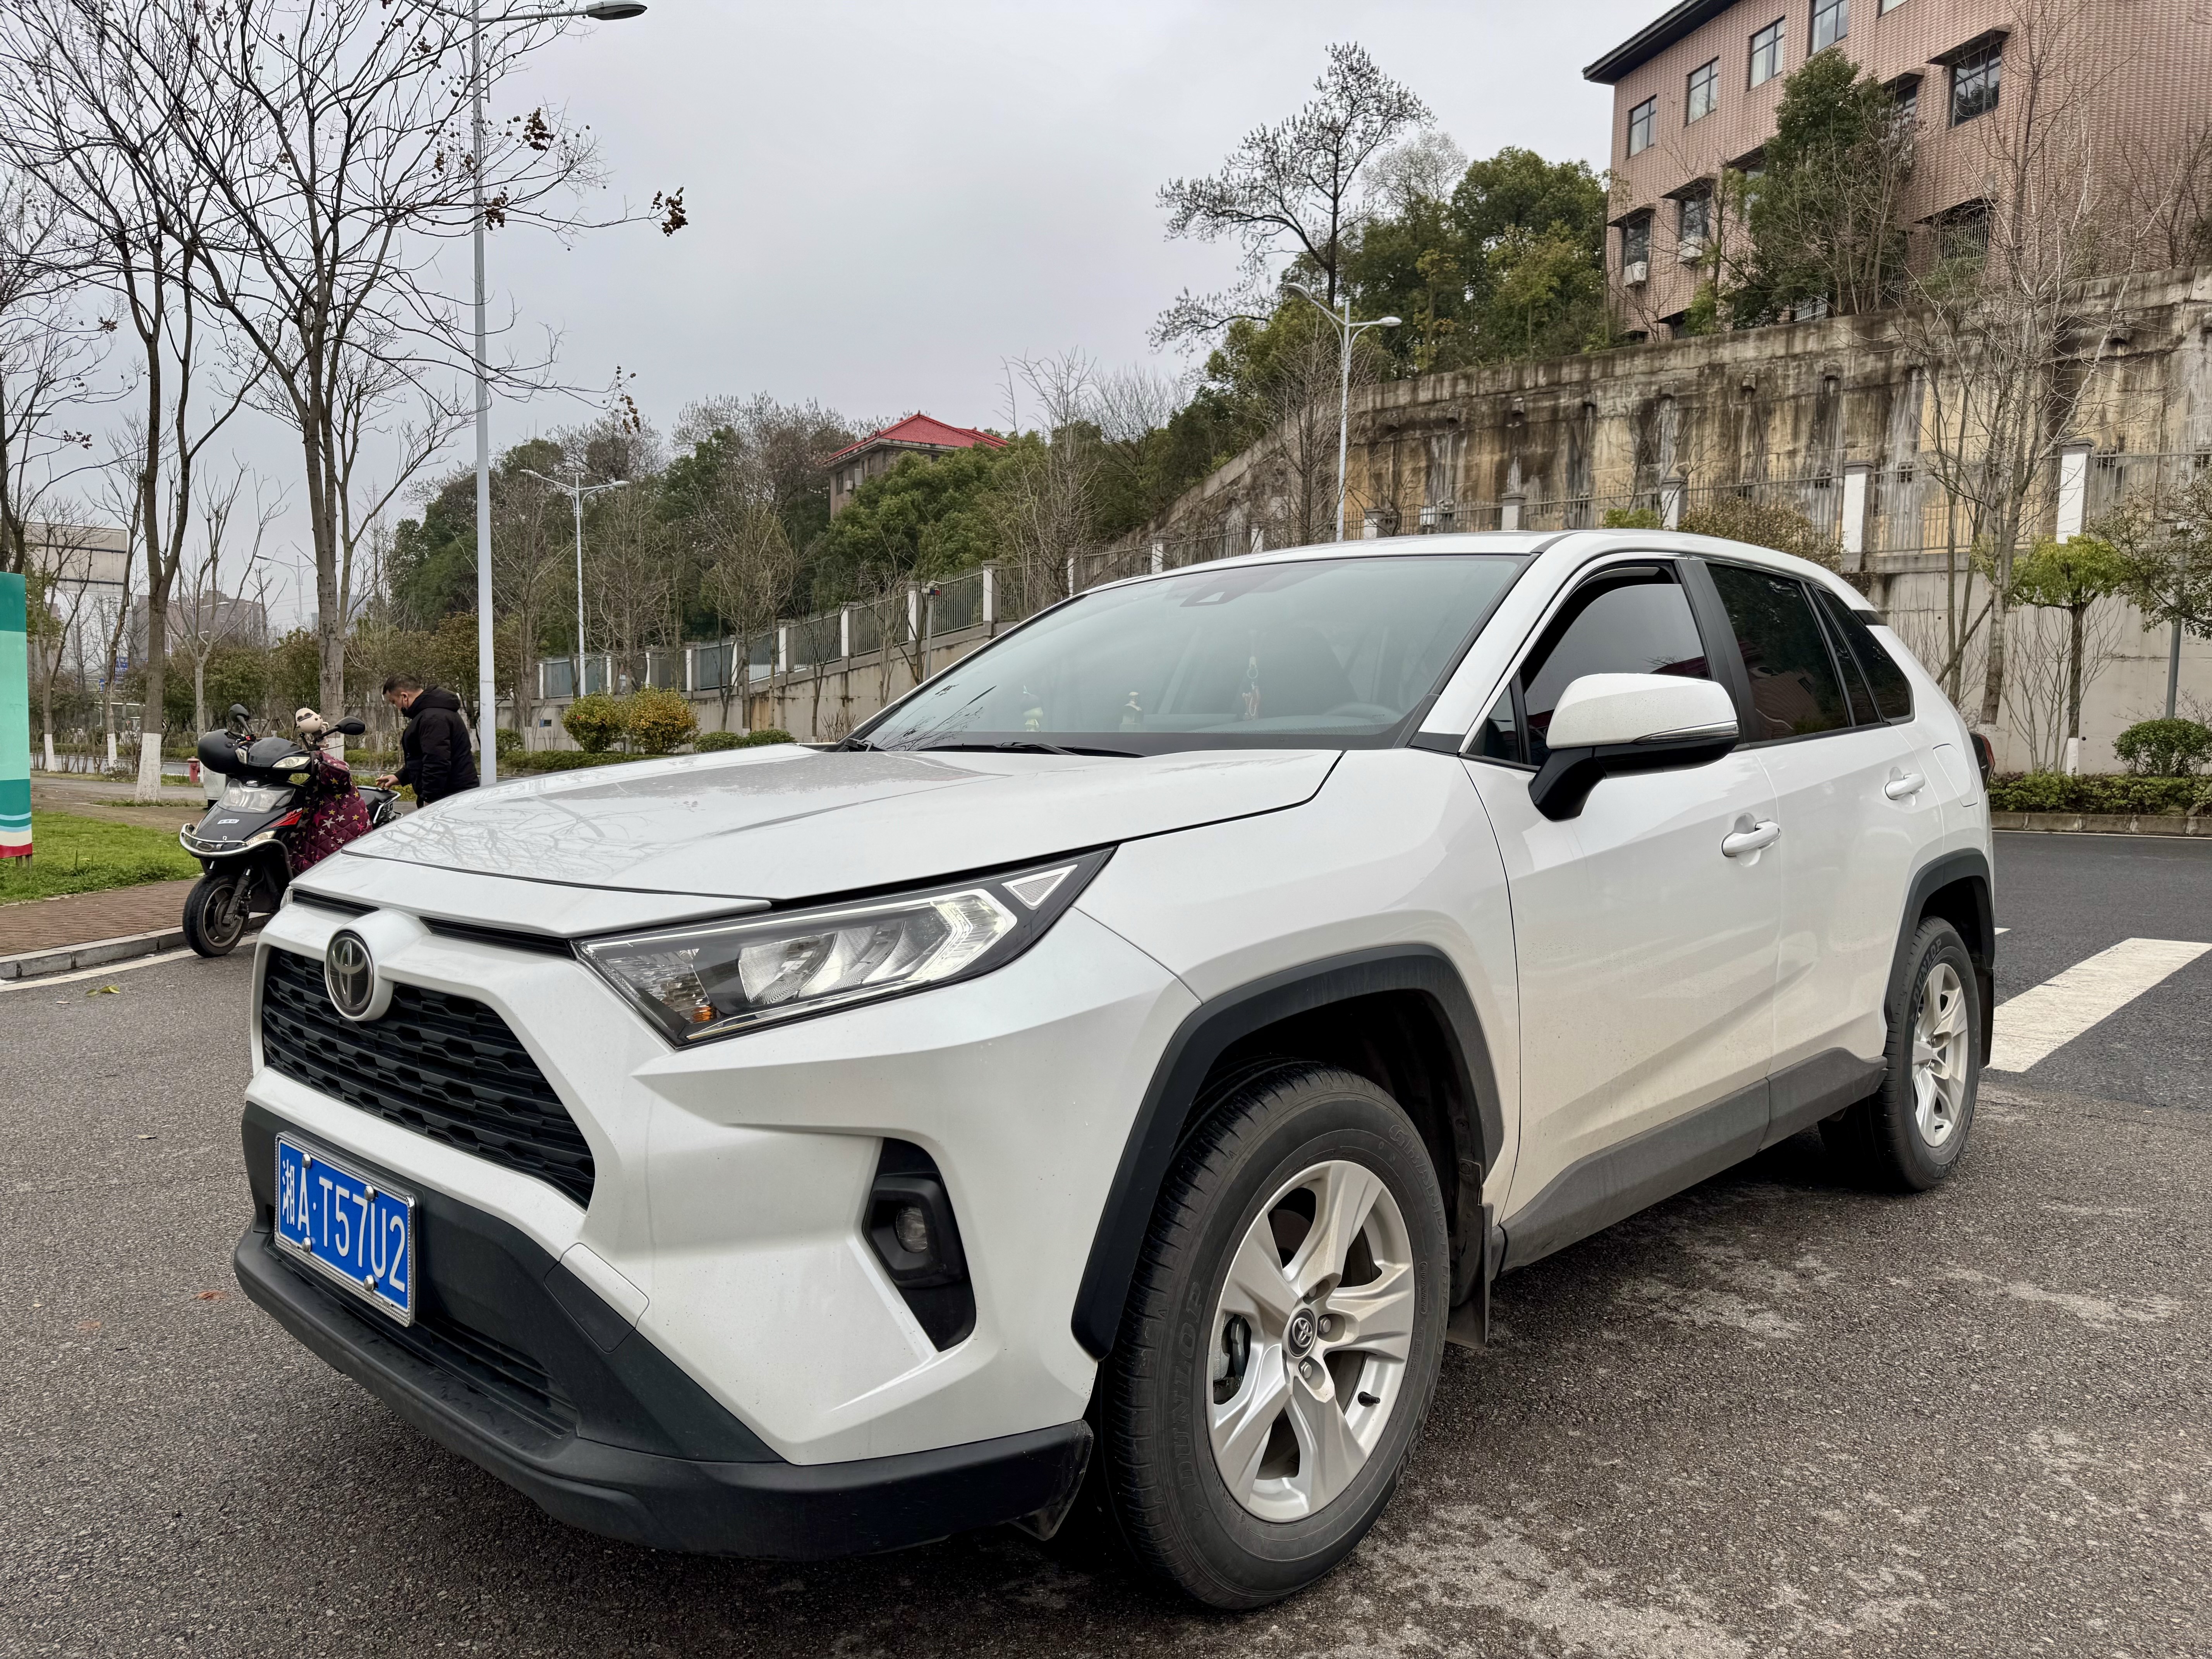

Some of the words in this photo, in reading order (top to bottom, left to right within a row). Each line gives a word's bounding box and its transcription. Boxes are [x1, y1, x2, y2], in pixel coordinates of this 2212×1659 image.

[1913, 938, 1941, 1005] DUNLOP
[282, 1159, 405, 1293] 湘A·T57U2
[1172, 1282, 1201, 1490] DUNLOP
